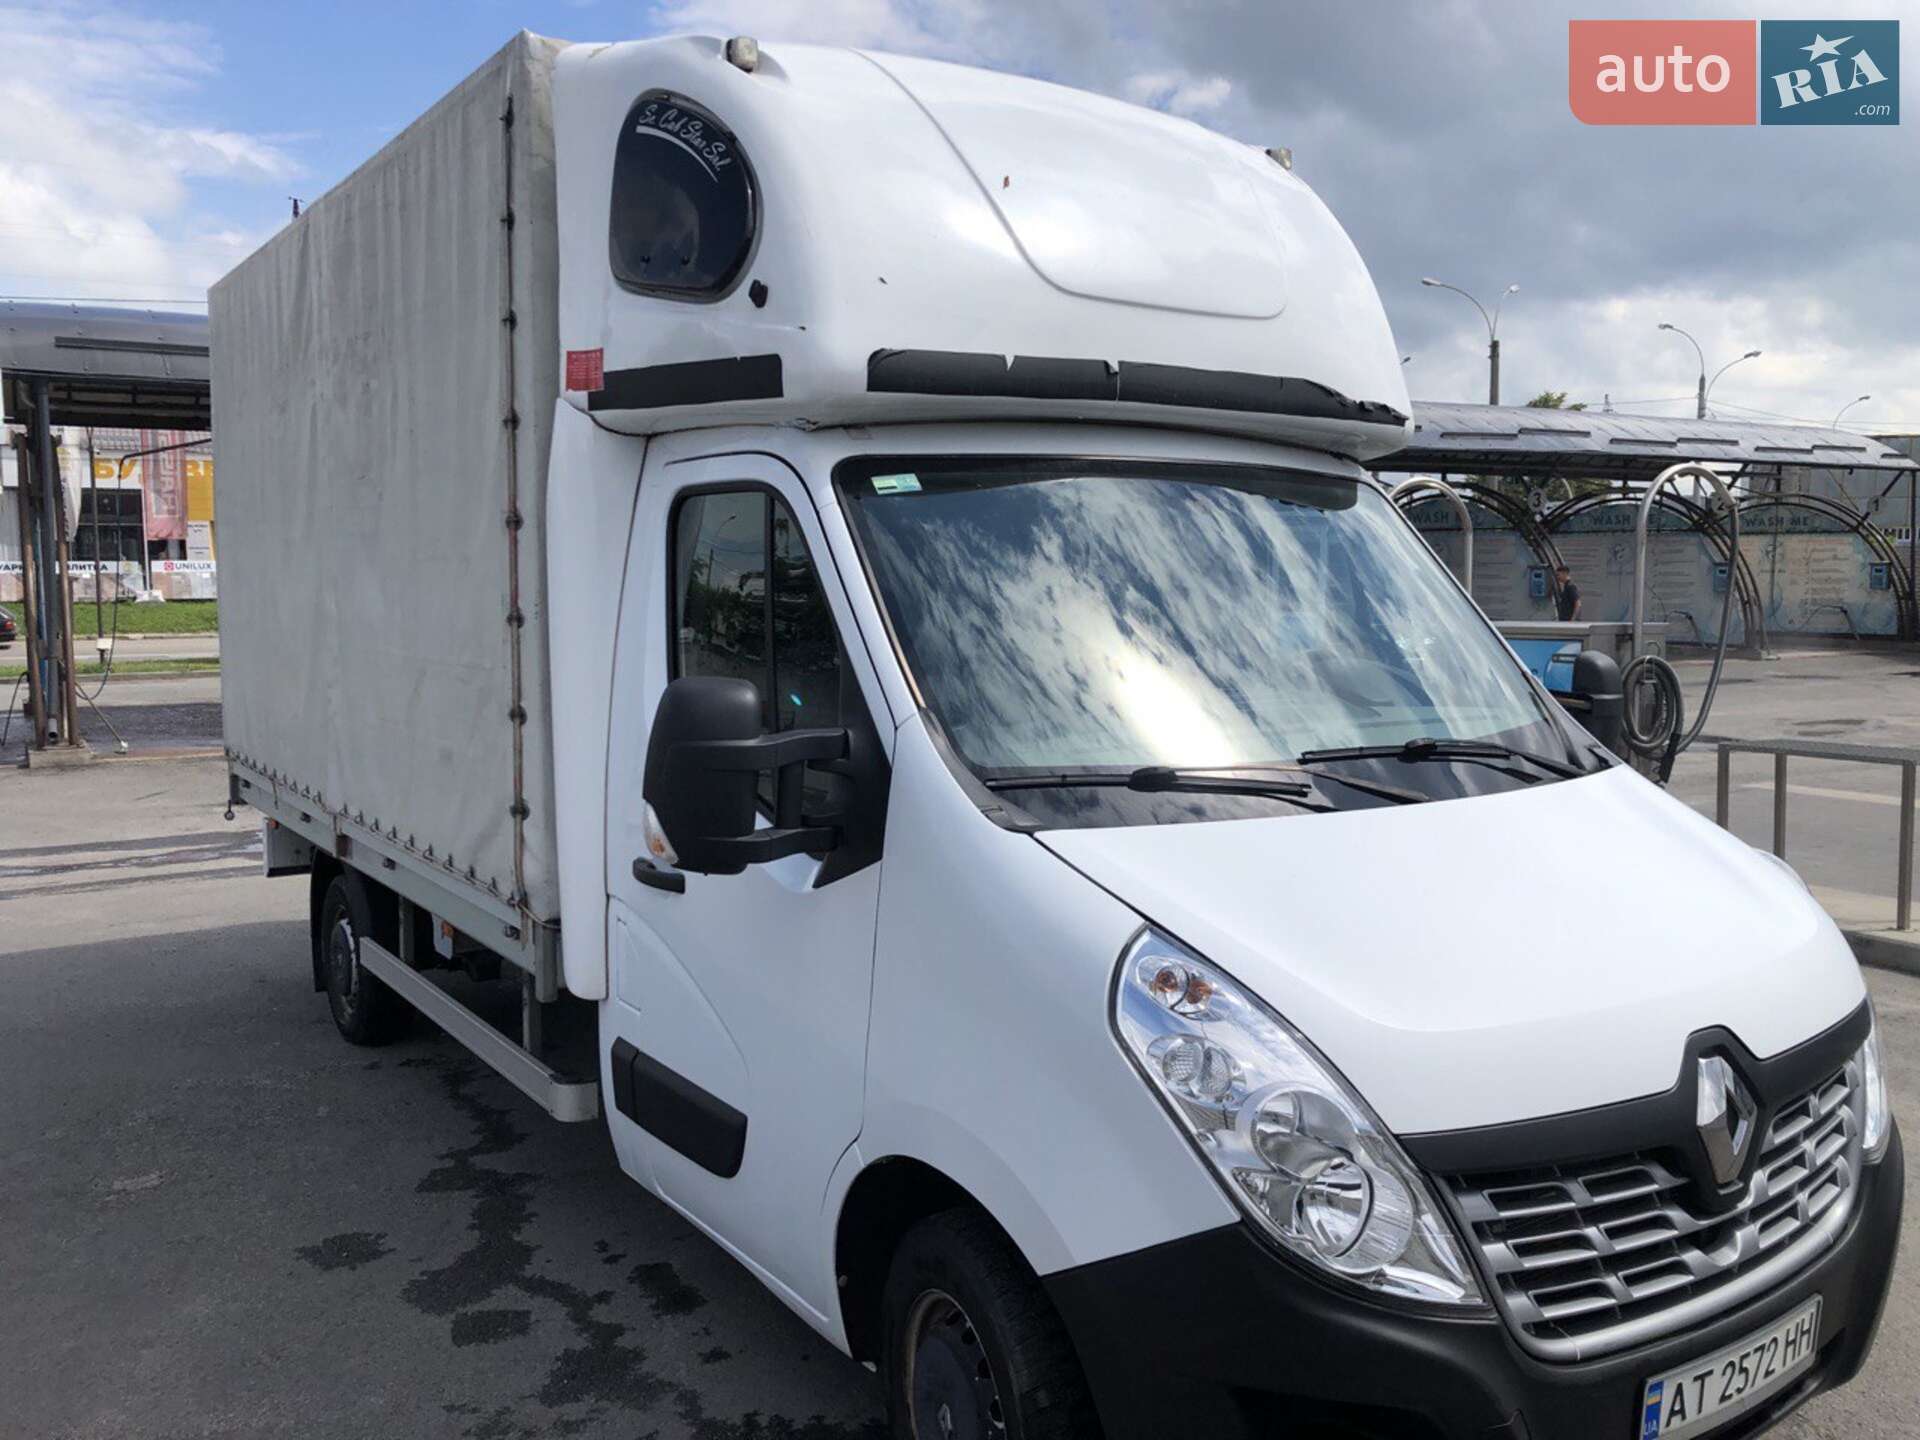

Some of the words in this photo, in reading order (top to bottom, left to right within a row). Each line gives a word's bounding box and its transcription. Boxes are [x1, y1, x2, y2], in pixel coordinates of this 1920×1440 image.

[1411, 511, 1449, 524] WASH
[1592, 513, 1632, 526] WASH
[1745, 516, 1785, 527] WASH
[1666, 1369, 1714, 1428] AT
[1718, 1336, 1779, 1405] 2572
[1782, 1311, 1814, 1367] HH
